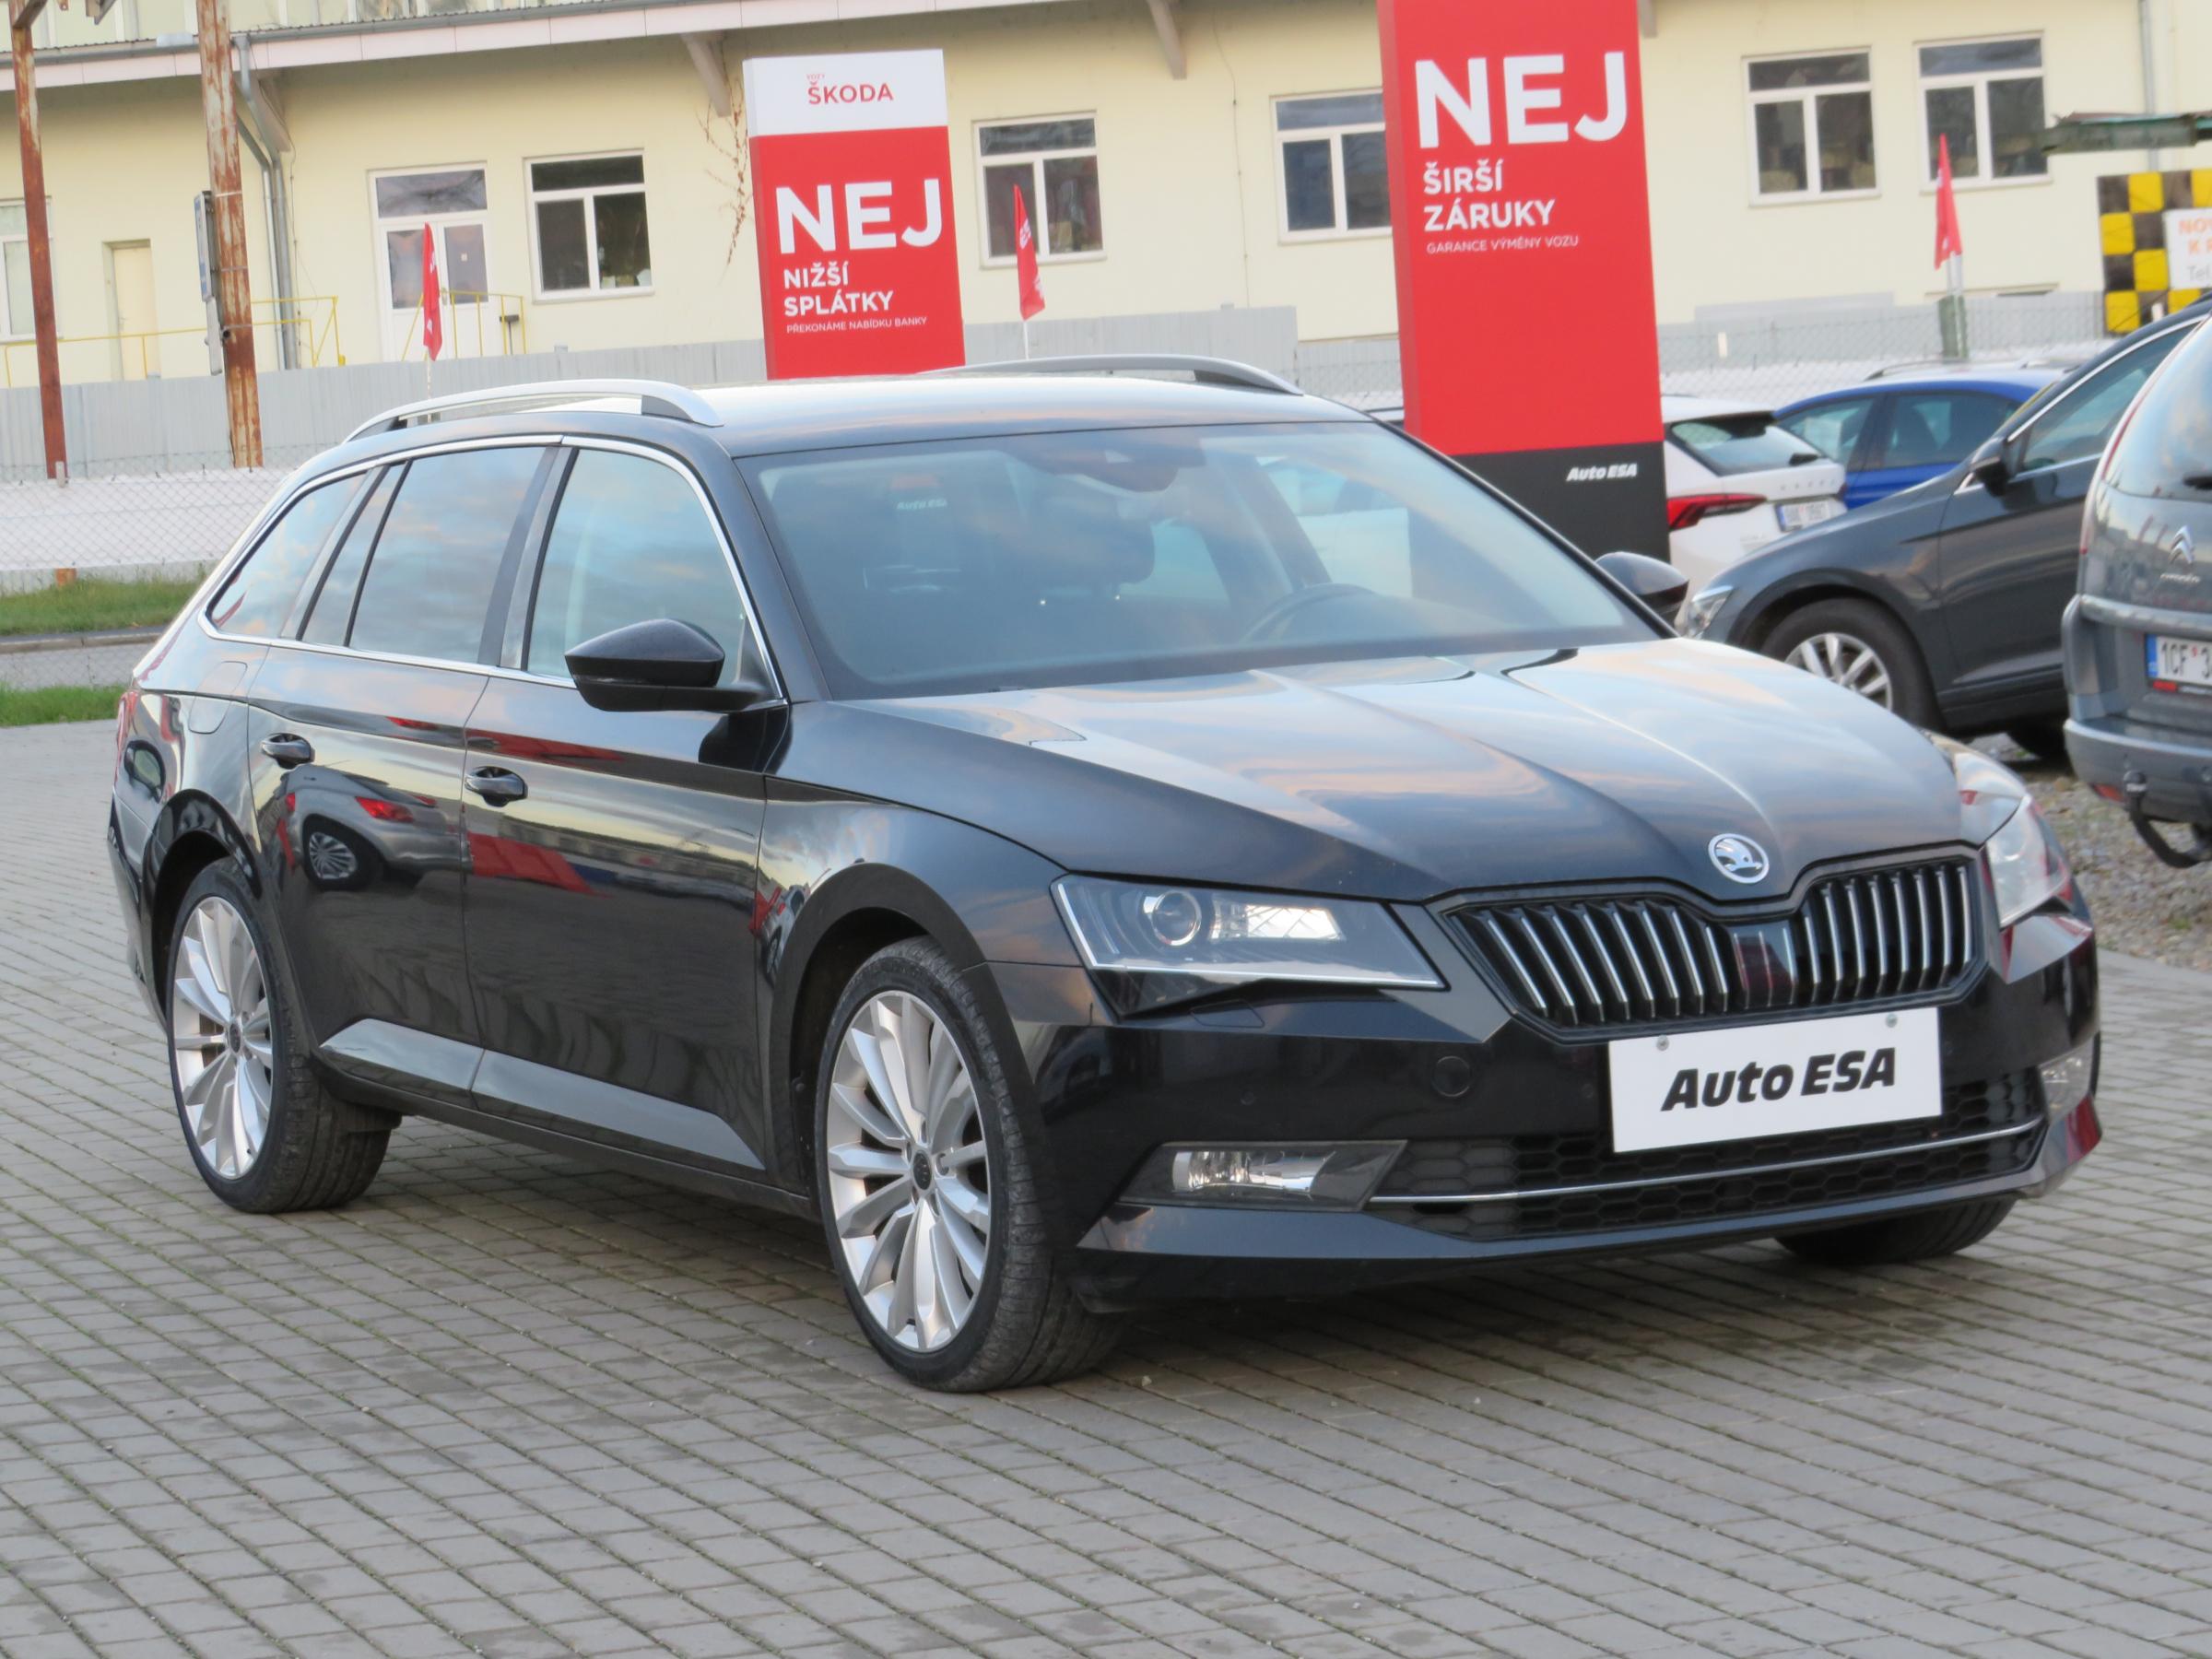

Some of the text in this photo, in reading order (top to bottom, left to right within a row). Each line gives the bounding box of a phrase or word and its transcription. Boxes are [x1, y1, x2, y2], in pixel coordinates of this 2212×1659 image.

[807, 80, 894, 105] ŠKODA
[1415, 51, 1628, 148] NEJ
[1423, 159, 1504, 195] ŠIRŠÍ
[775, 178, 943, 254] NEJ
[1423, 198, 1556, 231] ZÁRUKY
[1426, 234, 1579, 254] GARANCE VÝMĚNY VOZU
[783, 260, 850, 288] NIŽŠÍ
[783, 289, 894, 317] SPLÁTKY
[786, 315, 927, 334] PŘEKONÁME NABÍDKU BANKY
[1566, 463, 1638, 482] Auto ESA
[1659, 1046, 1896, 1112] Auto ESA
